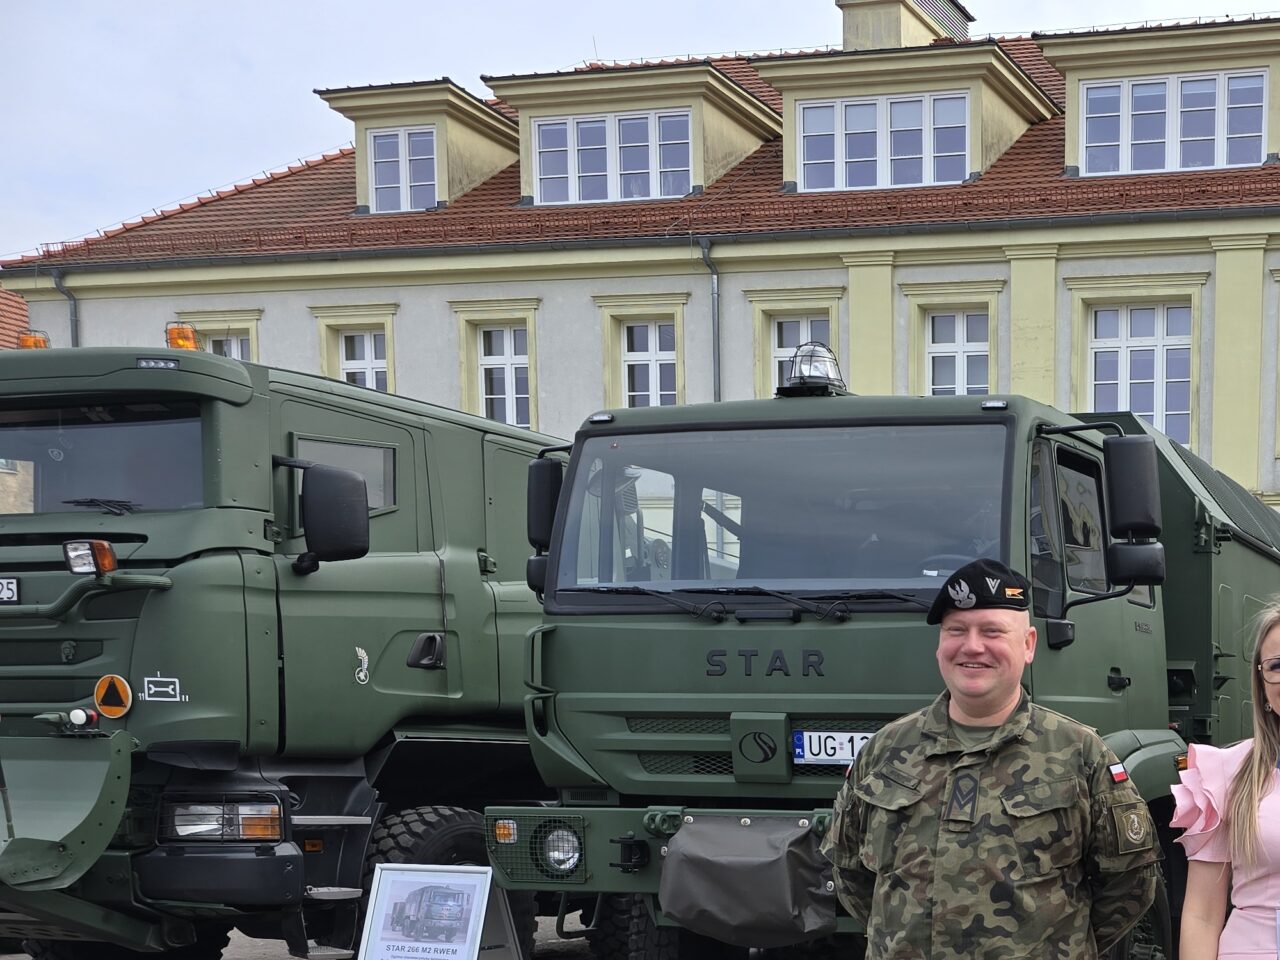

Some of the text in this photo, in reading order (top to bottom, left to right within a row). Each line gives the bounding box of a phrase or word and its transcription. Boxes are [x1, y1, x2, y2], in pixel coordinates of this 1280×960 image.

[706, 649, 825, 677] STAR
[808, 735, 870, 758] UG 1
[385, 944, 406, 952] STAR
[407, 945, 420, 953] 266
[433, 947, 458, 955] RWEM
